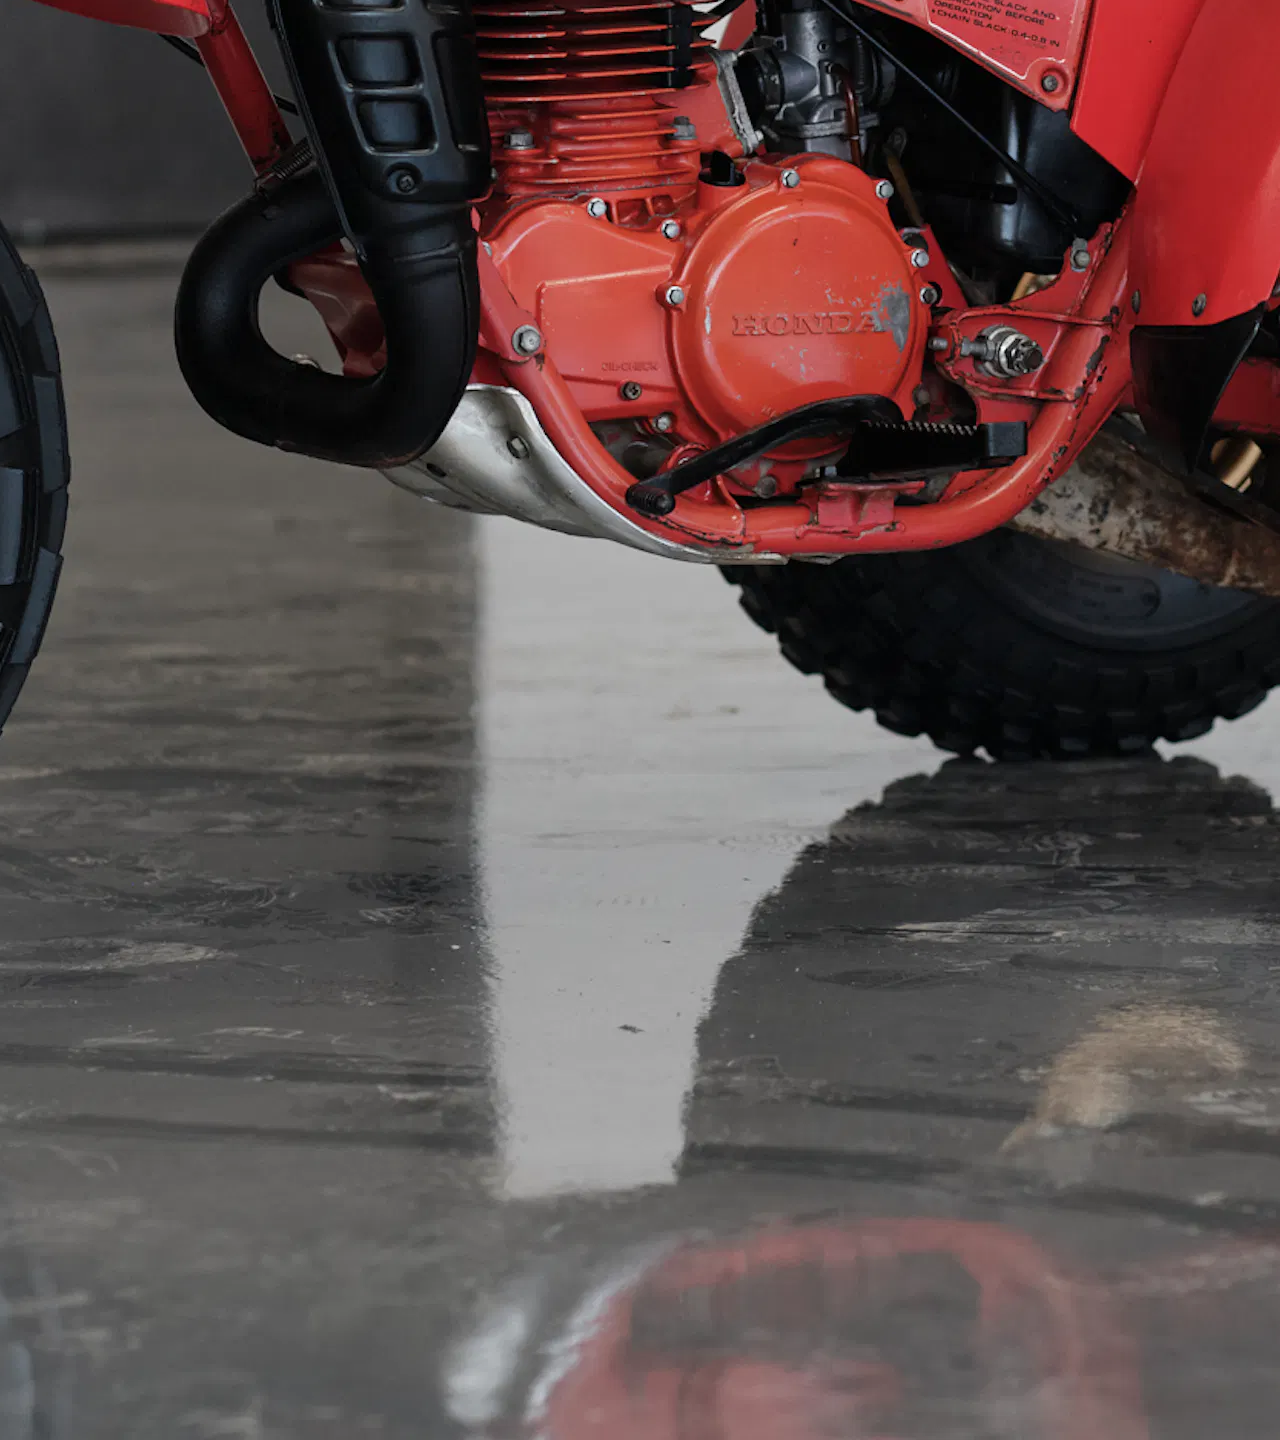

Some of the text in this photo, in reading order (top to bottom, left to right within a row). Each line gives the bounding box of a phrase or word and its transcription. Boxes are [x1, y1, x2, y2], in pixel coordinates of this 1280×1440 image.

[934, 0, 993, 21] OPERATION
[1005, 10, 1045, 26] BEFORE
[1032, 8, 1057, 21] AND
[937, 9, 970, 24] CHAIN
[1049, 39, 1060, 48] IN
[731, 312, 887, 336] HONDA
